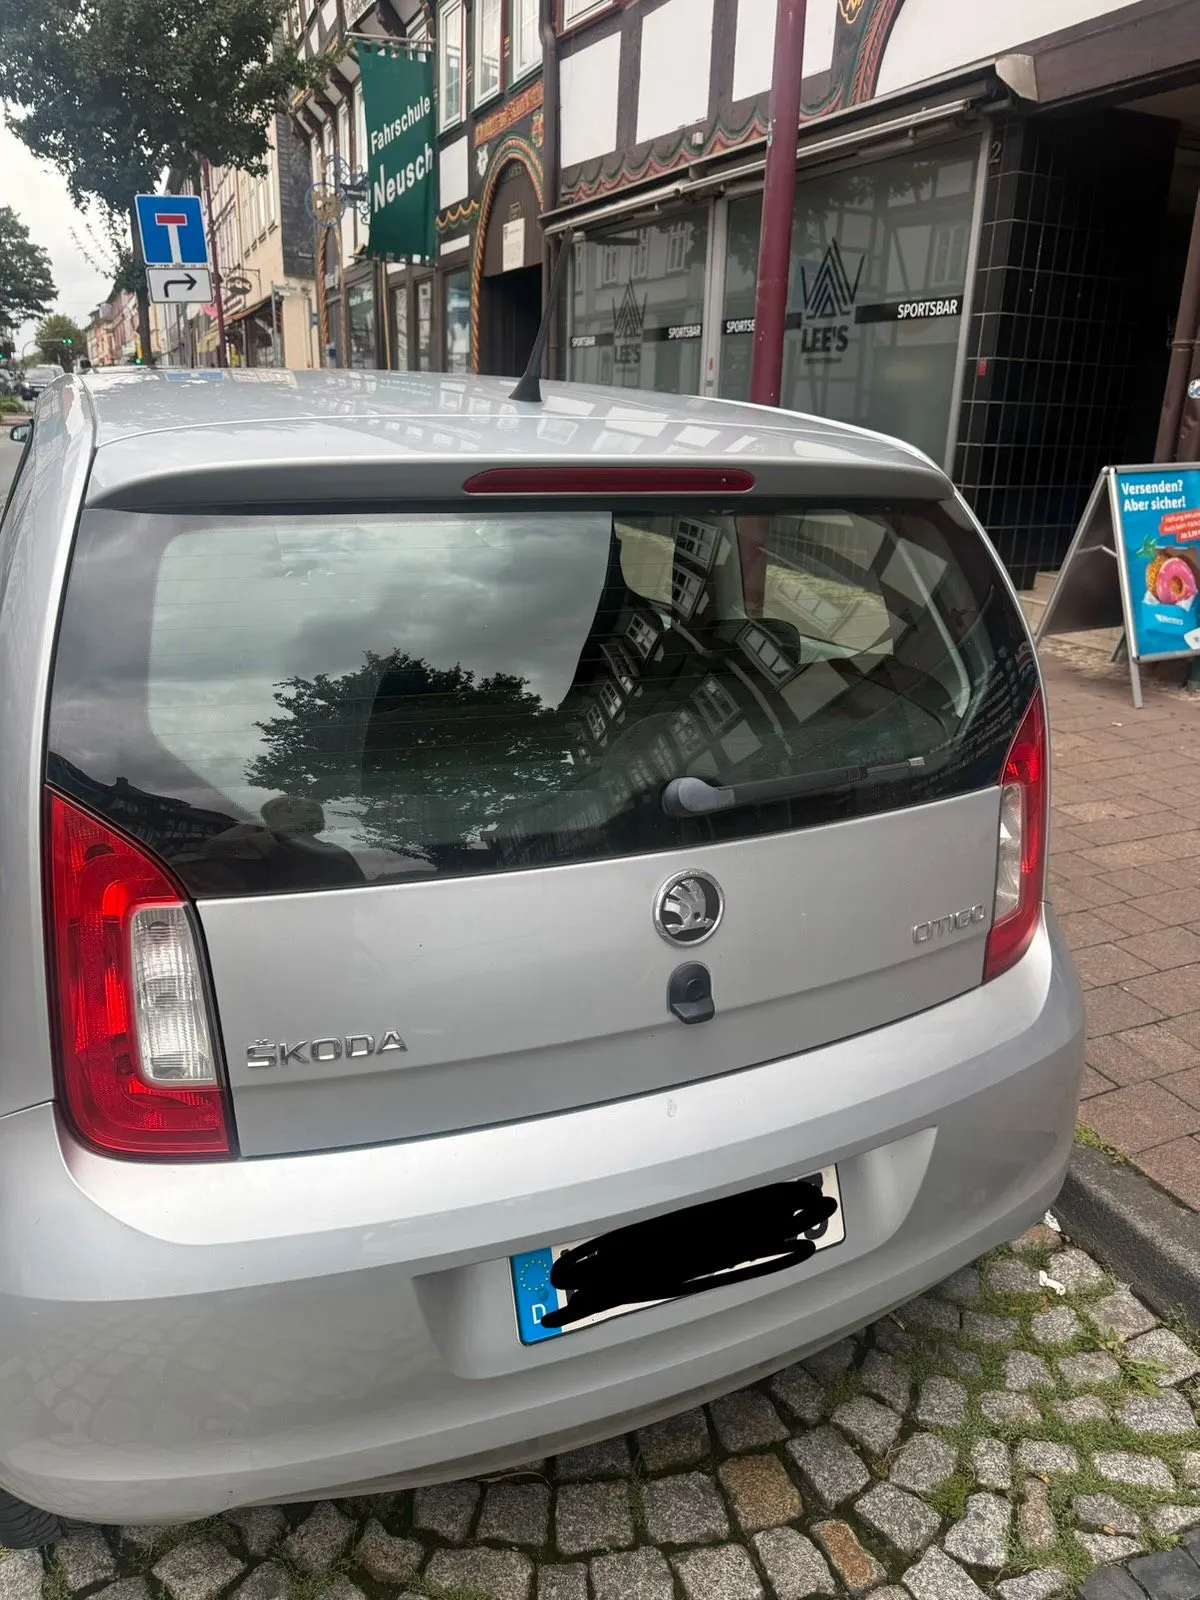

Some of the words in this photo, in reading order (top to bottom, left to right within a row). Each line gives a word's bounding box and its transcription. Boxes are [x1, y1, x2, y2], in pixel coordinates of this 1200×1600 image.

[371, 95, 431, 155] Fahrschule
[990, 142, 1003, 165] 2
[373, 142, 433, 213] Neusch
[897, 299, 958, 319] SPORTSBAR
[571, 336, 596, 347] SPORTSBAR
[667, 323, 702, 340] SPORTSBAR
[801, 325, 850, 355] LEE'S
[1121, 480, 1183, 495] Versenden?
[1124, 499, 1149, 511] Aber
[1151, 495, 1187, 510] sicher!
[912, 903, 986, 945] CITIGO
[246, 1026, 409, 1069] ŠKODA
[531, 1303, 547, 1326] D
